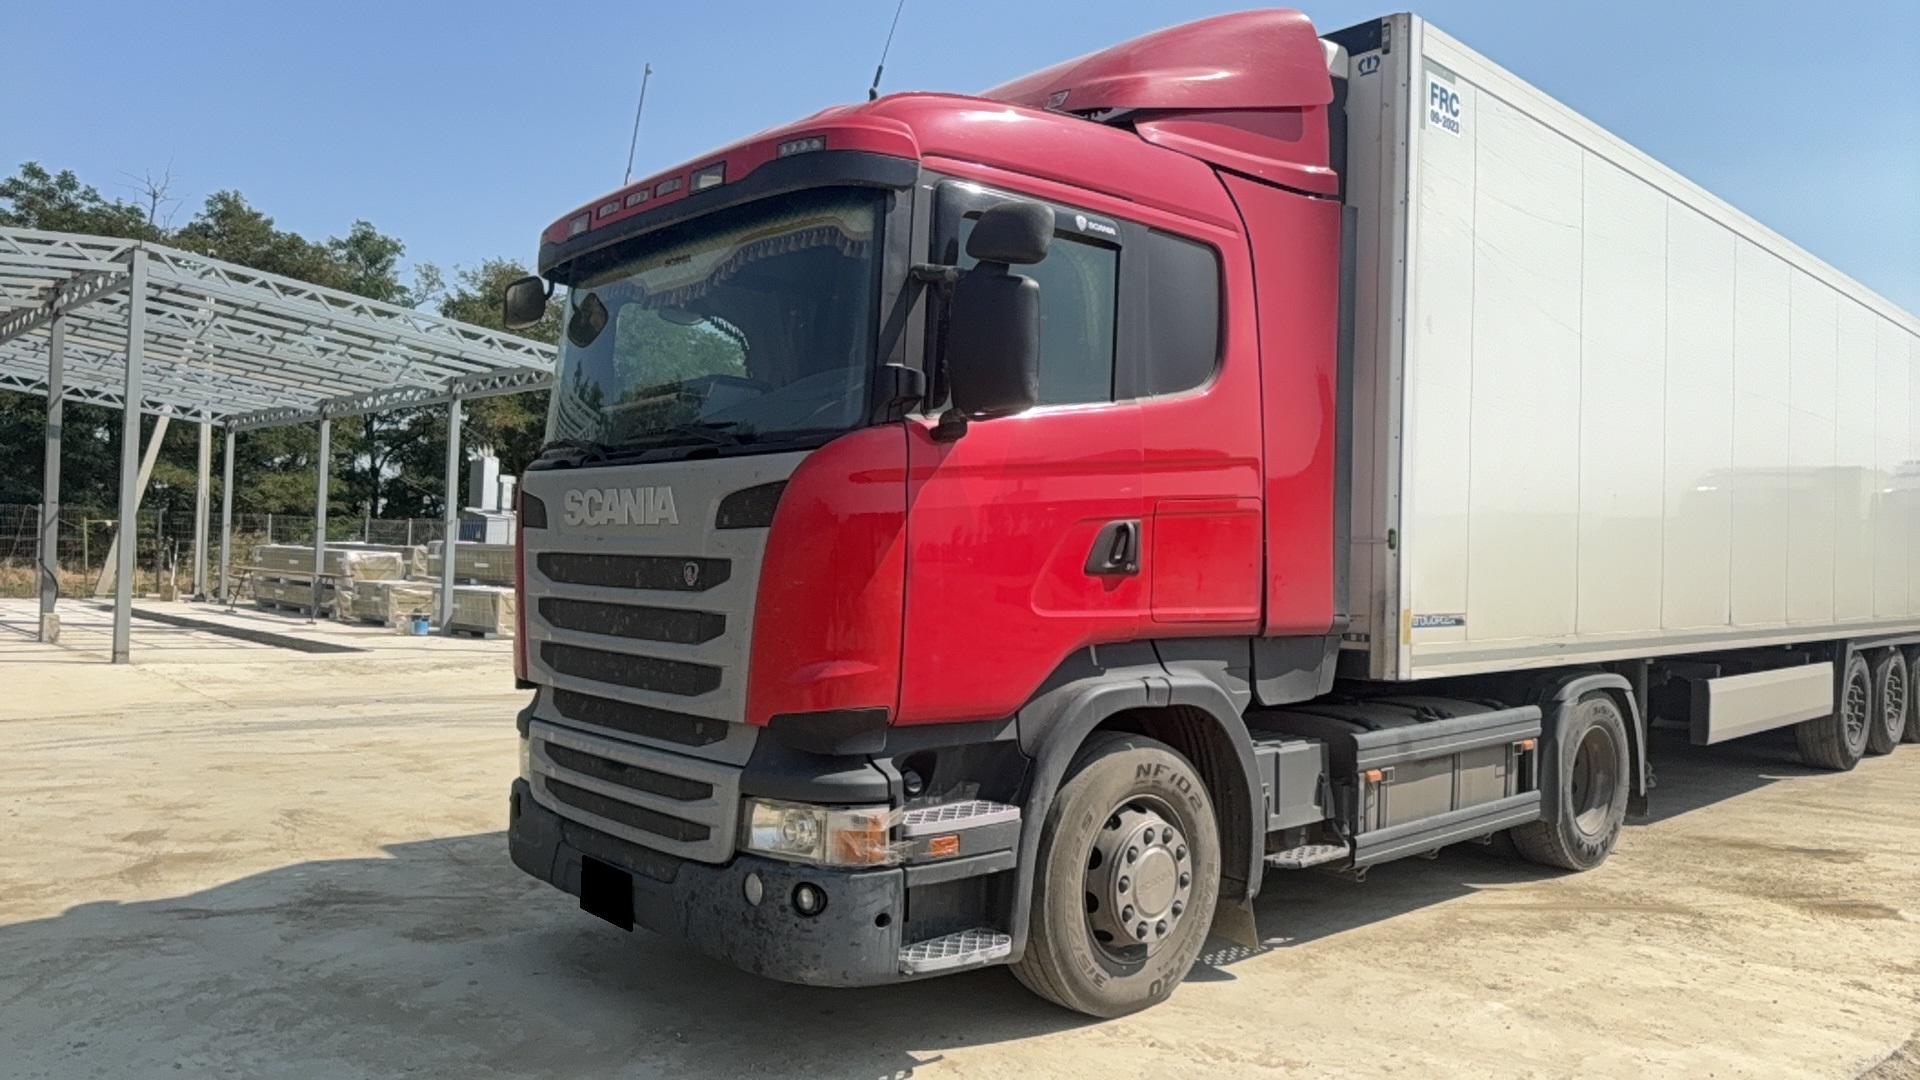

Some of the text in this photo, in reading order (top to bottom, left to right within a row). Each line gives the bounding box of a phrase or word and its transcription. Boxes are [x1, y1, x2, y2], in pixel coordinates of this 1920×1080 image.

[1430, 82, 1460, 117] FRC
[1430, 109, 1460, 134] 09-2023
[563, 486, 679, 526] SCANIA
